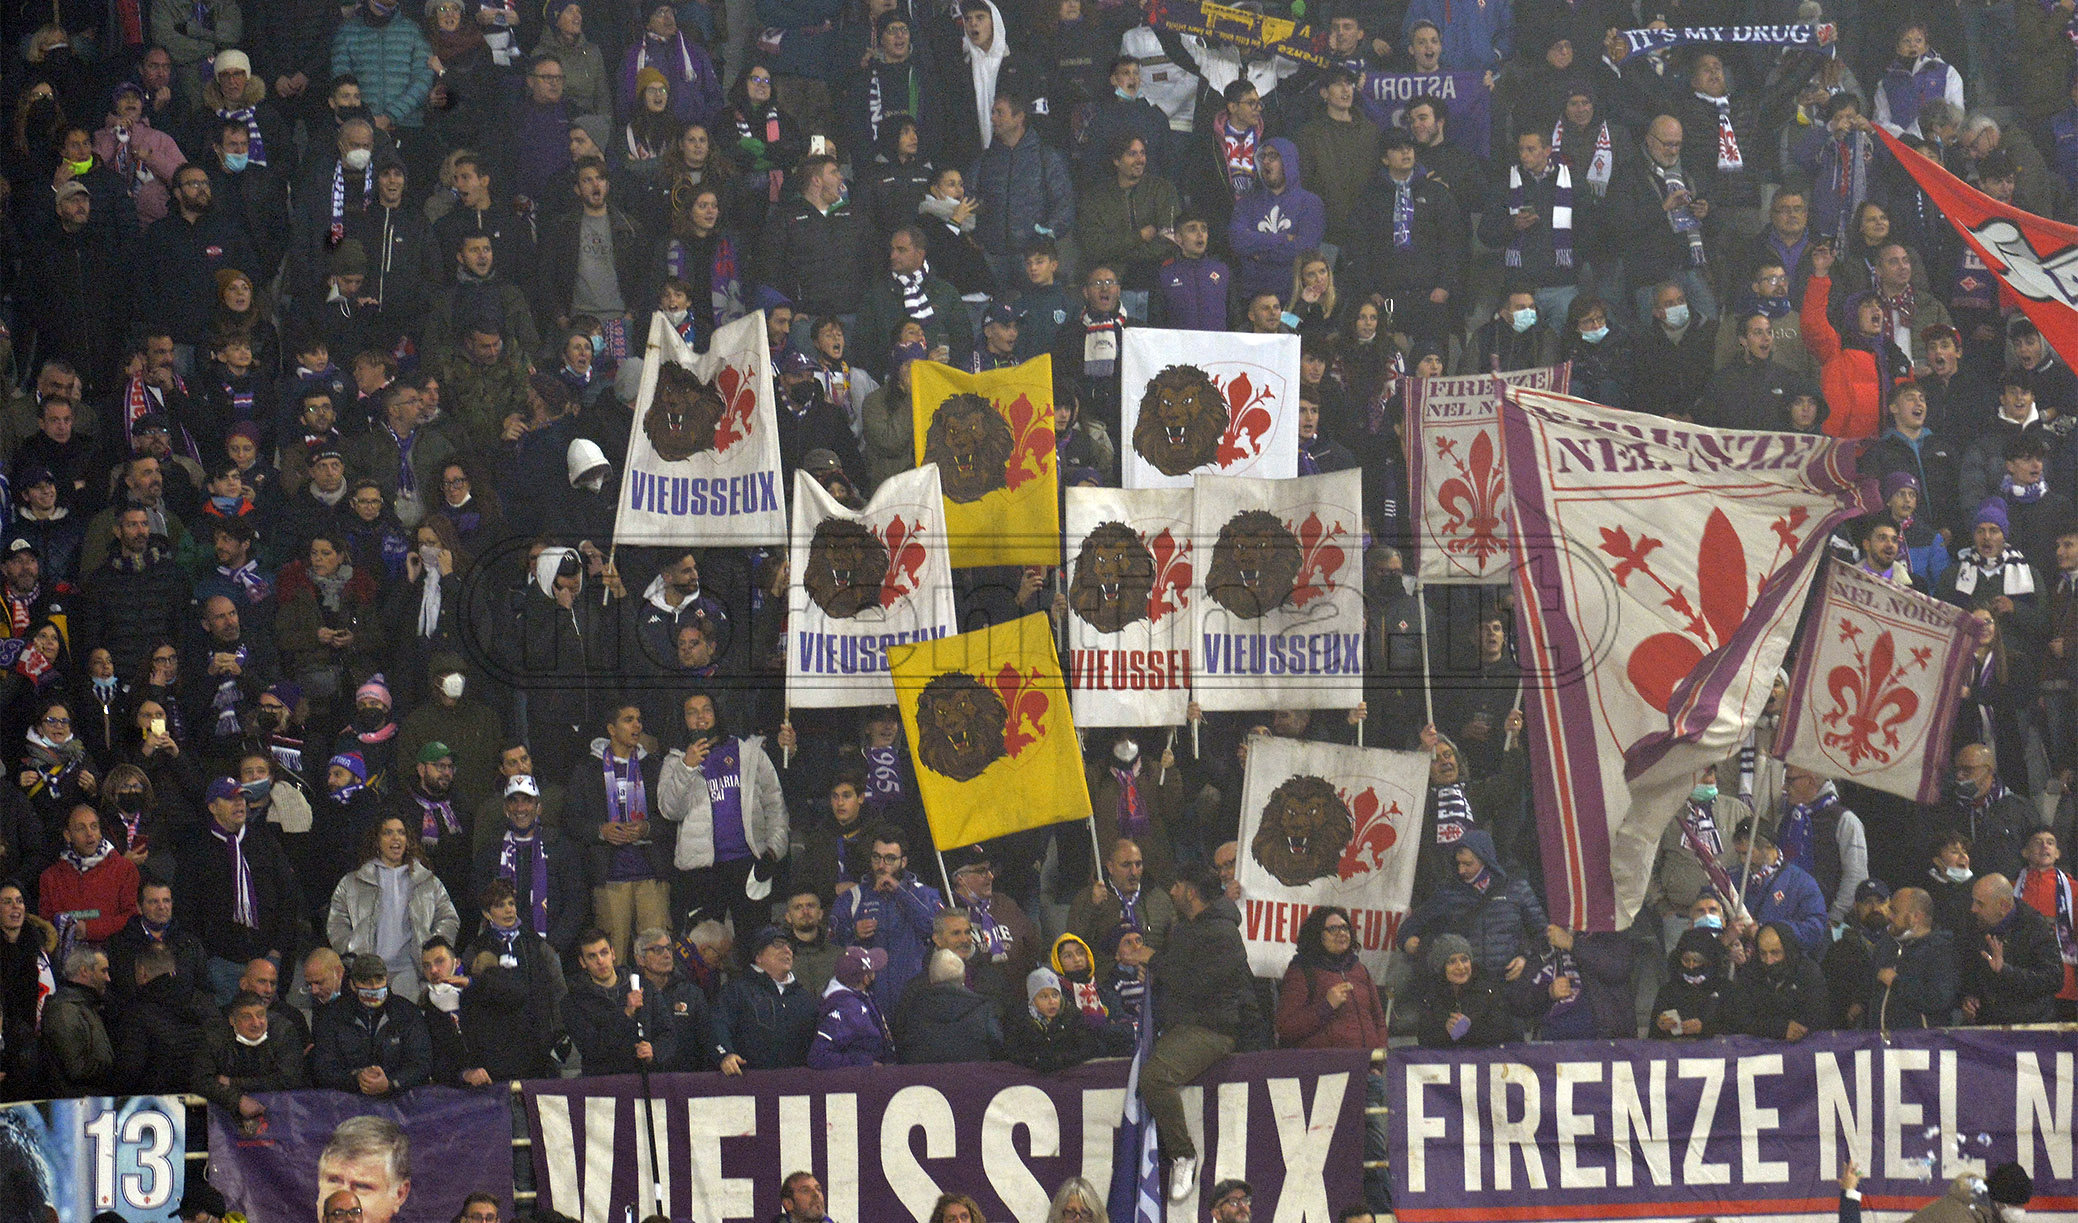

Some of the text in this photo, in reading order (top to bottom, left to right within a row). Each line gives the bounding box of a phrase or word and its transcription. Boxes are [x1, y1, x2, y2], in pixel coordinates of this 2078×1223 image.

[1623, 24, 1810, 52] IT'S MY DRUG
[1429, 371, 1547, 398] FIREZE
[1426, 402, 1472, 417] NEL
[631, 470, 779, 517] VIEUSSEUX
[1204, 633, 1360, 676] VIEUSSEUX
[1246, 899, 1403, 952] VIEUEUX
[1405, 1054, 1790, 1192] FIRENZE
[1815, 1049, 1987, 1181] NEL
[85, 1109, 175, 1210] 13
